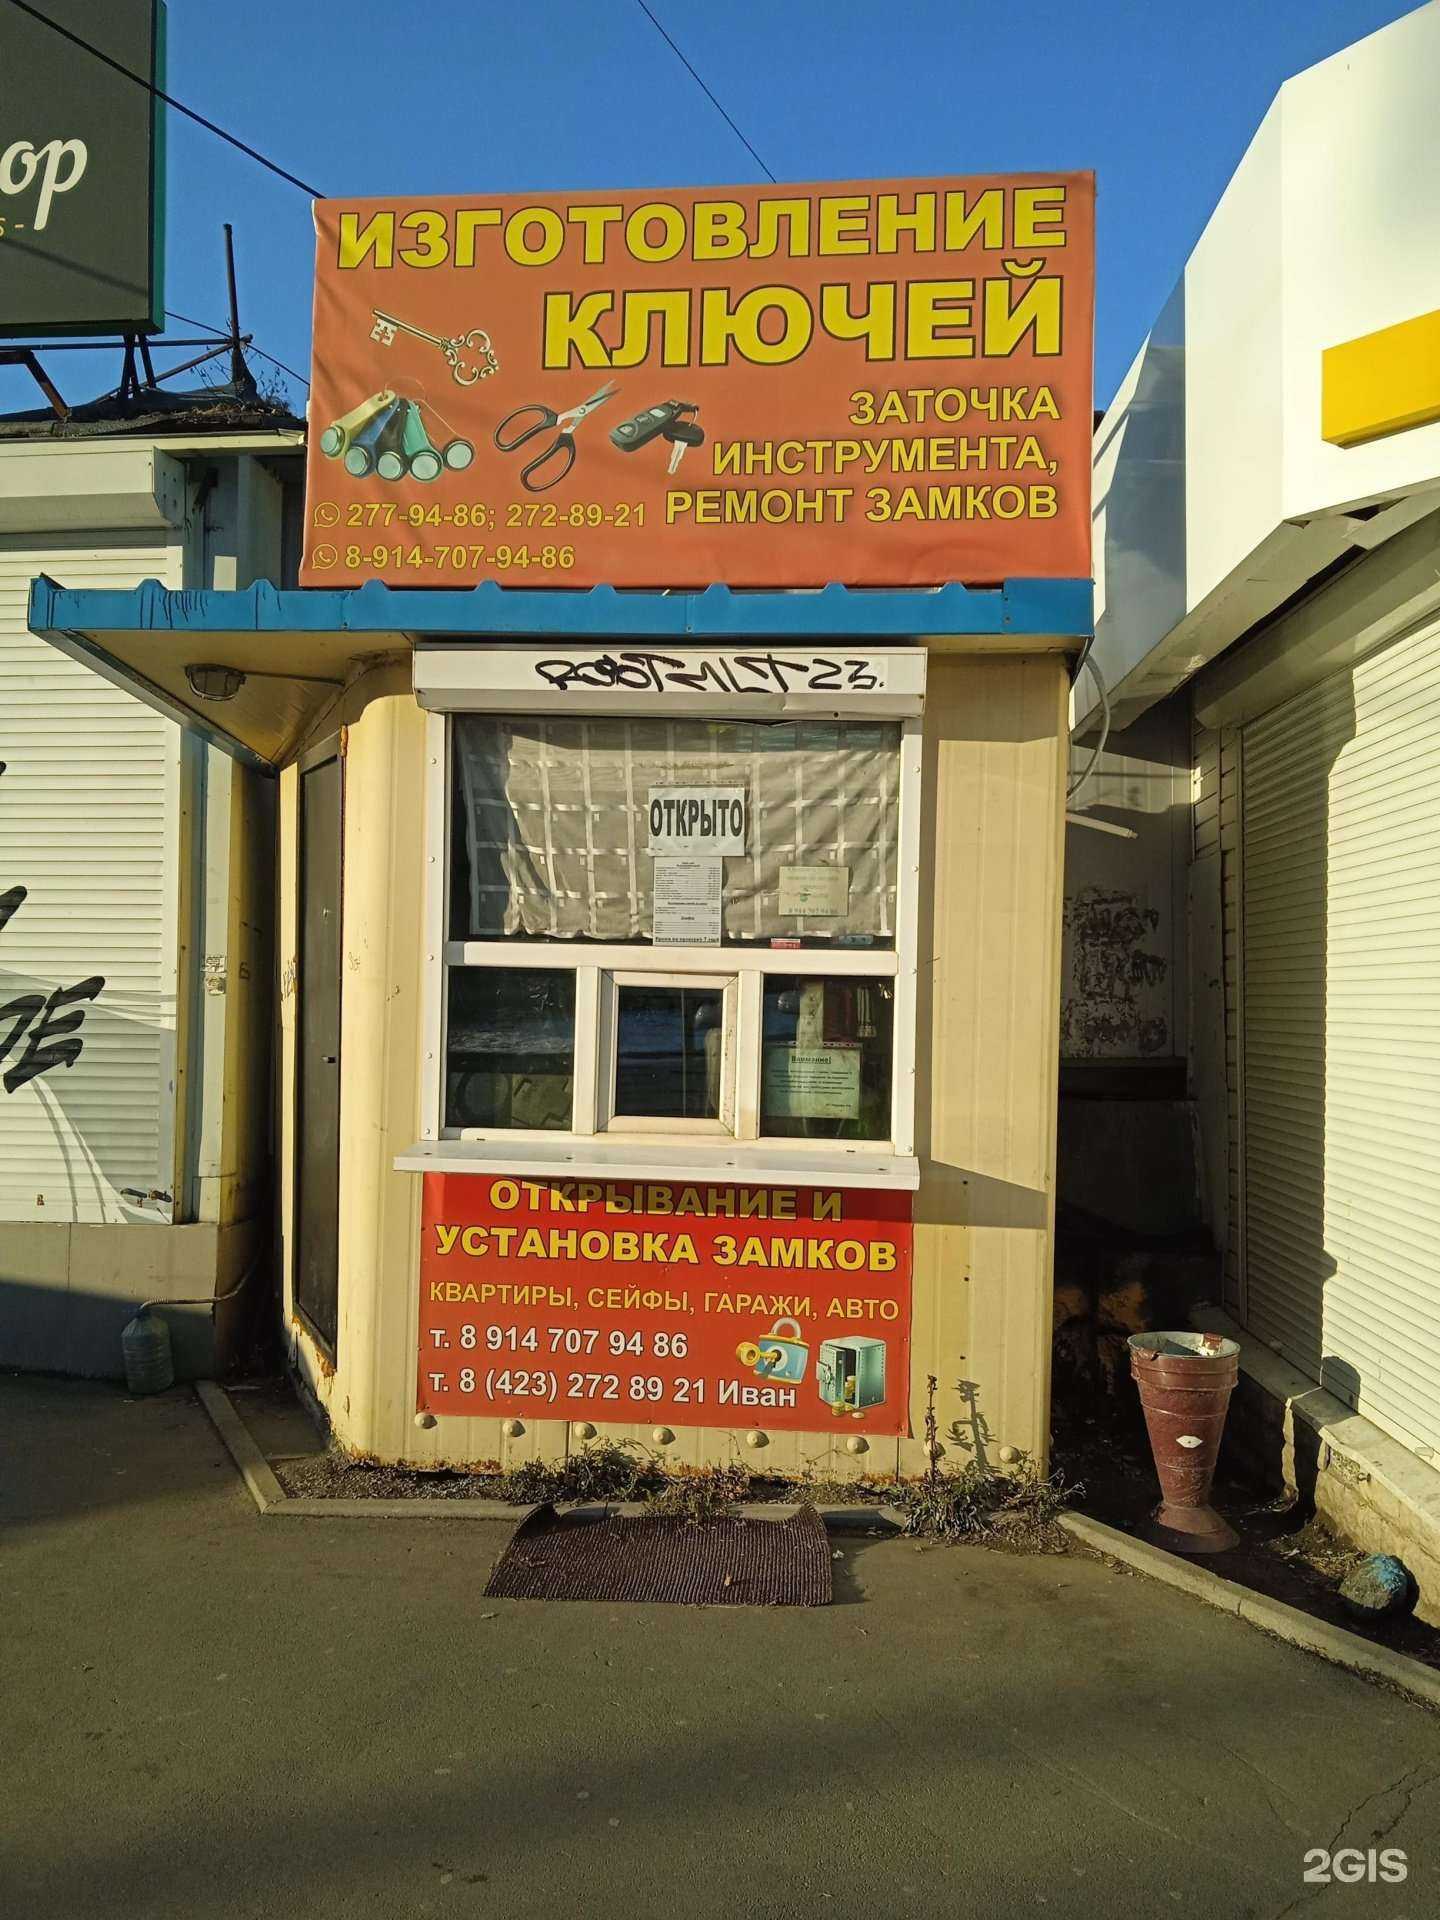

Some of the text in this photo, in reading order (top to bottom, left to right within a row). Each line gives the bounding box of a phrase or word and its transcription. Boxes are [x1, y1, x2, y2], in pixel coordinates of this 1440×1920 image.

[337, 185, 1067, 269] ИЗГОТОВЛЕНИЕ
[543, 257, 1064, 369] КЛЮЧЕЙ
[848, 386, 1061, 425] ЗАТОЧКА
[712, 435, 1059, 477] ИНСТРУМЕНТА,
[346, 502, 646, 531] 277-94-86; 272-89-21
[665, 485, 1059, 525] РЕМОНТ ЗАМКОВ
[344, 545, 577, 569] 8-914-707-94-86
[650, 799, 744, 837] ОТКРЫТО
[489, 1180, 843, 1222] ОТКРЫВАНИЕ И
[434, 1224, 898, 1272] УСТАНОВКА ЗАМКОВ
[430, 1281, 900, 1320] КВАРТИРЫ, СЕЙФЫ, ГАРАЖИ, АВТО
[429, 1324, 688, 1358] т. 8 914 707 94 86
[428, 1368, 796, 1407] т. 8 (423) 272 89 21 Иван
